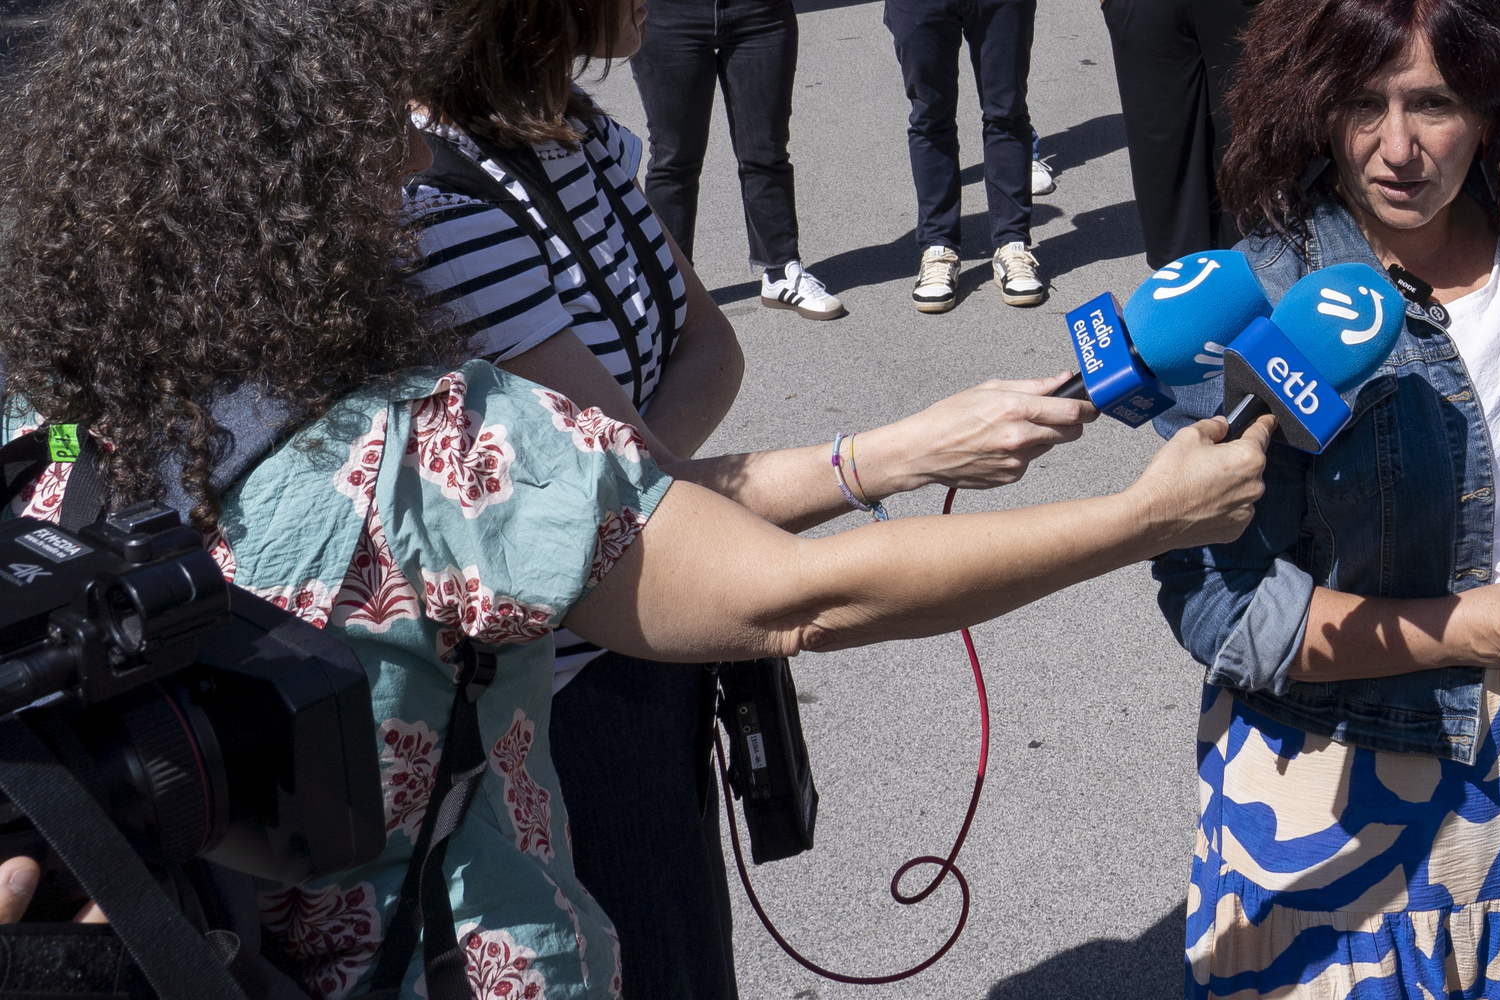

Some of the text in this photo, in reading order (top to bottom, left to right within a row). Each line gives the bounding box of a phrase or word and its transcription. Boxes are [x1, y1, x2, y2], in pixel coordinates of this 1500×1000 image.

[1073, 318, 1105, 375] euskadi
[1089, 308, 1114, 350] radio
[1265, 355, 1320, 415] etb
[8, 562, 54, 584] 4K
